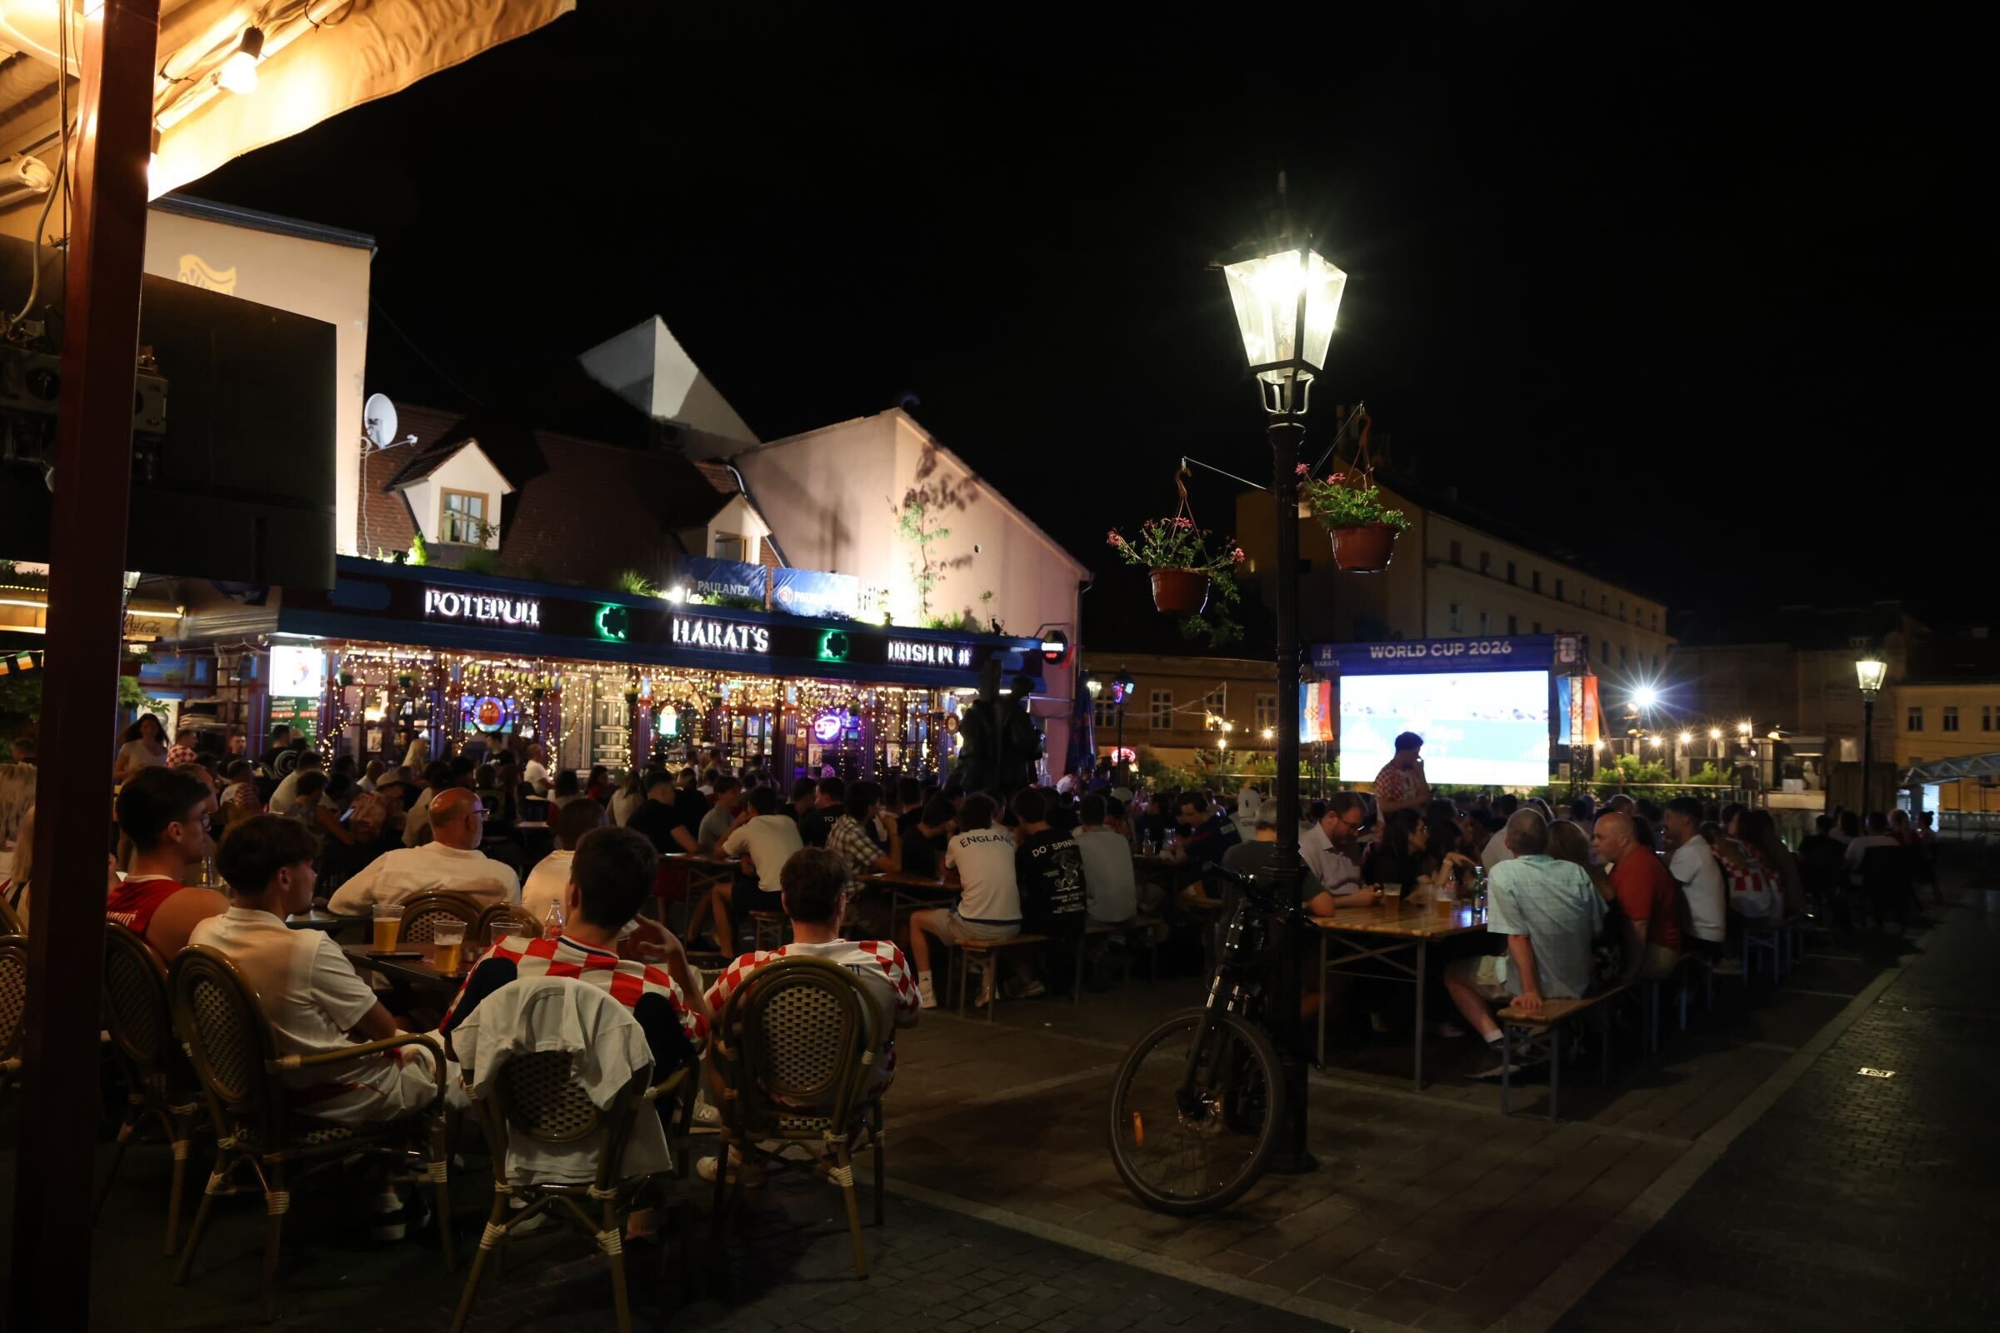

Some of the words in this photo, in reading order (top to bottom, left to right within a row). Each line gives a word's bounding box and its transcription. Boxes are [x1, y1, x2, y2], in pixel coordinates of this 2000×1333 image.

[697, 581, 750, 596] PAULANER
[672, 617, 770, 653] HARAT'S
[888, 641, 936, 667] IRISH
[1370, 644, 1427, 659] WORLD
[1430, 642, 1460, 657] CUP
[1468, 640, 1513, 656] 2026
[959, 834, 1014, 849] ENGLAND
